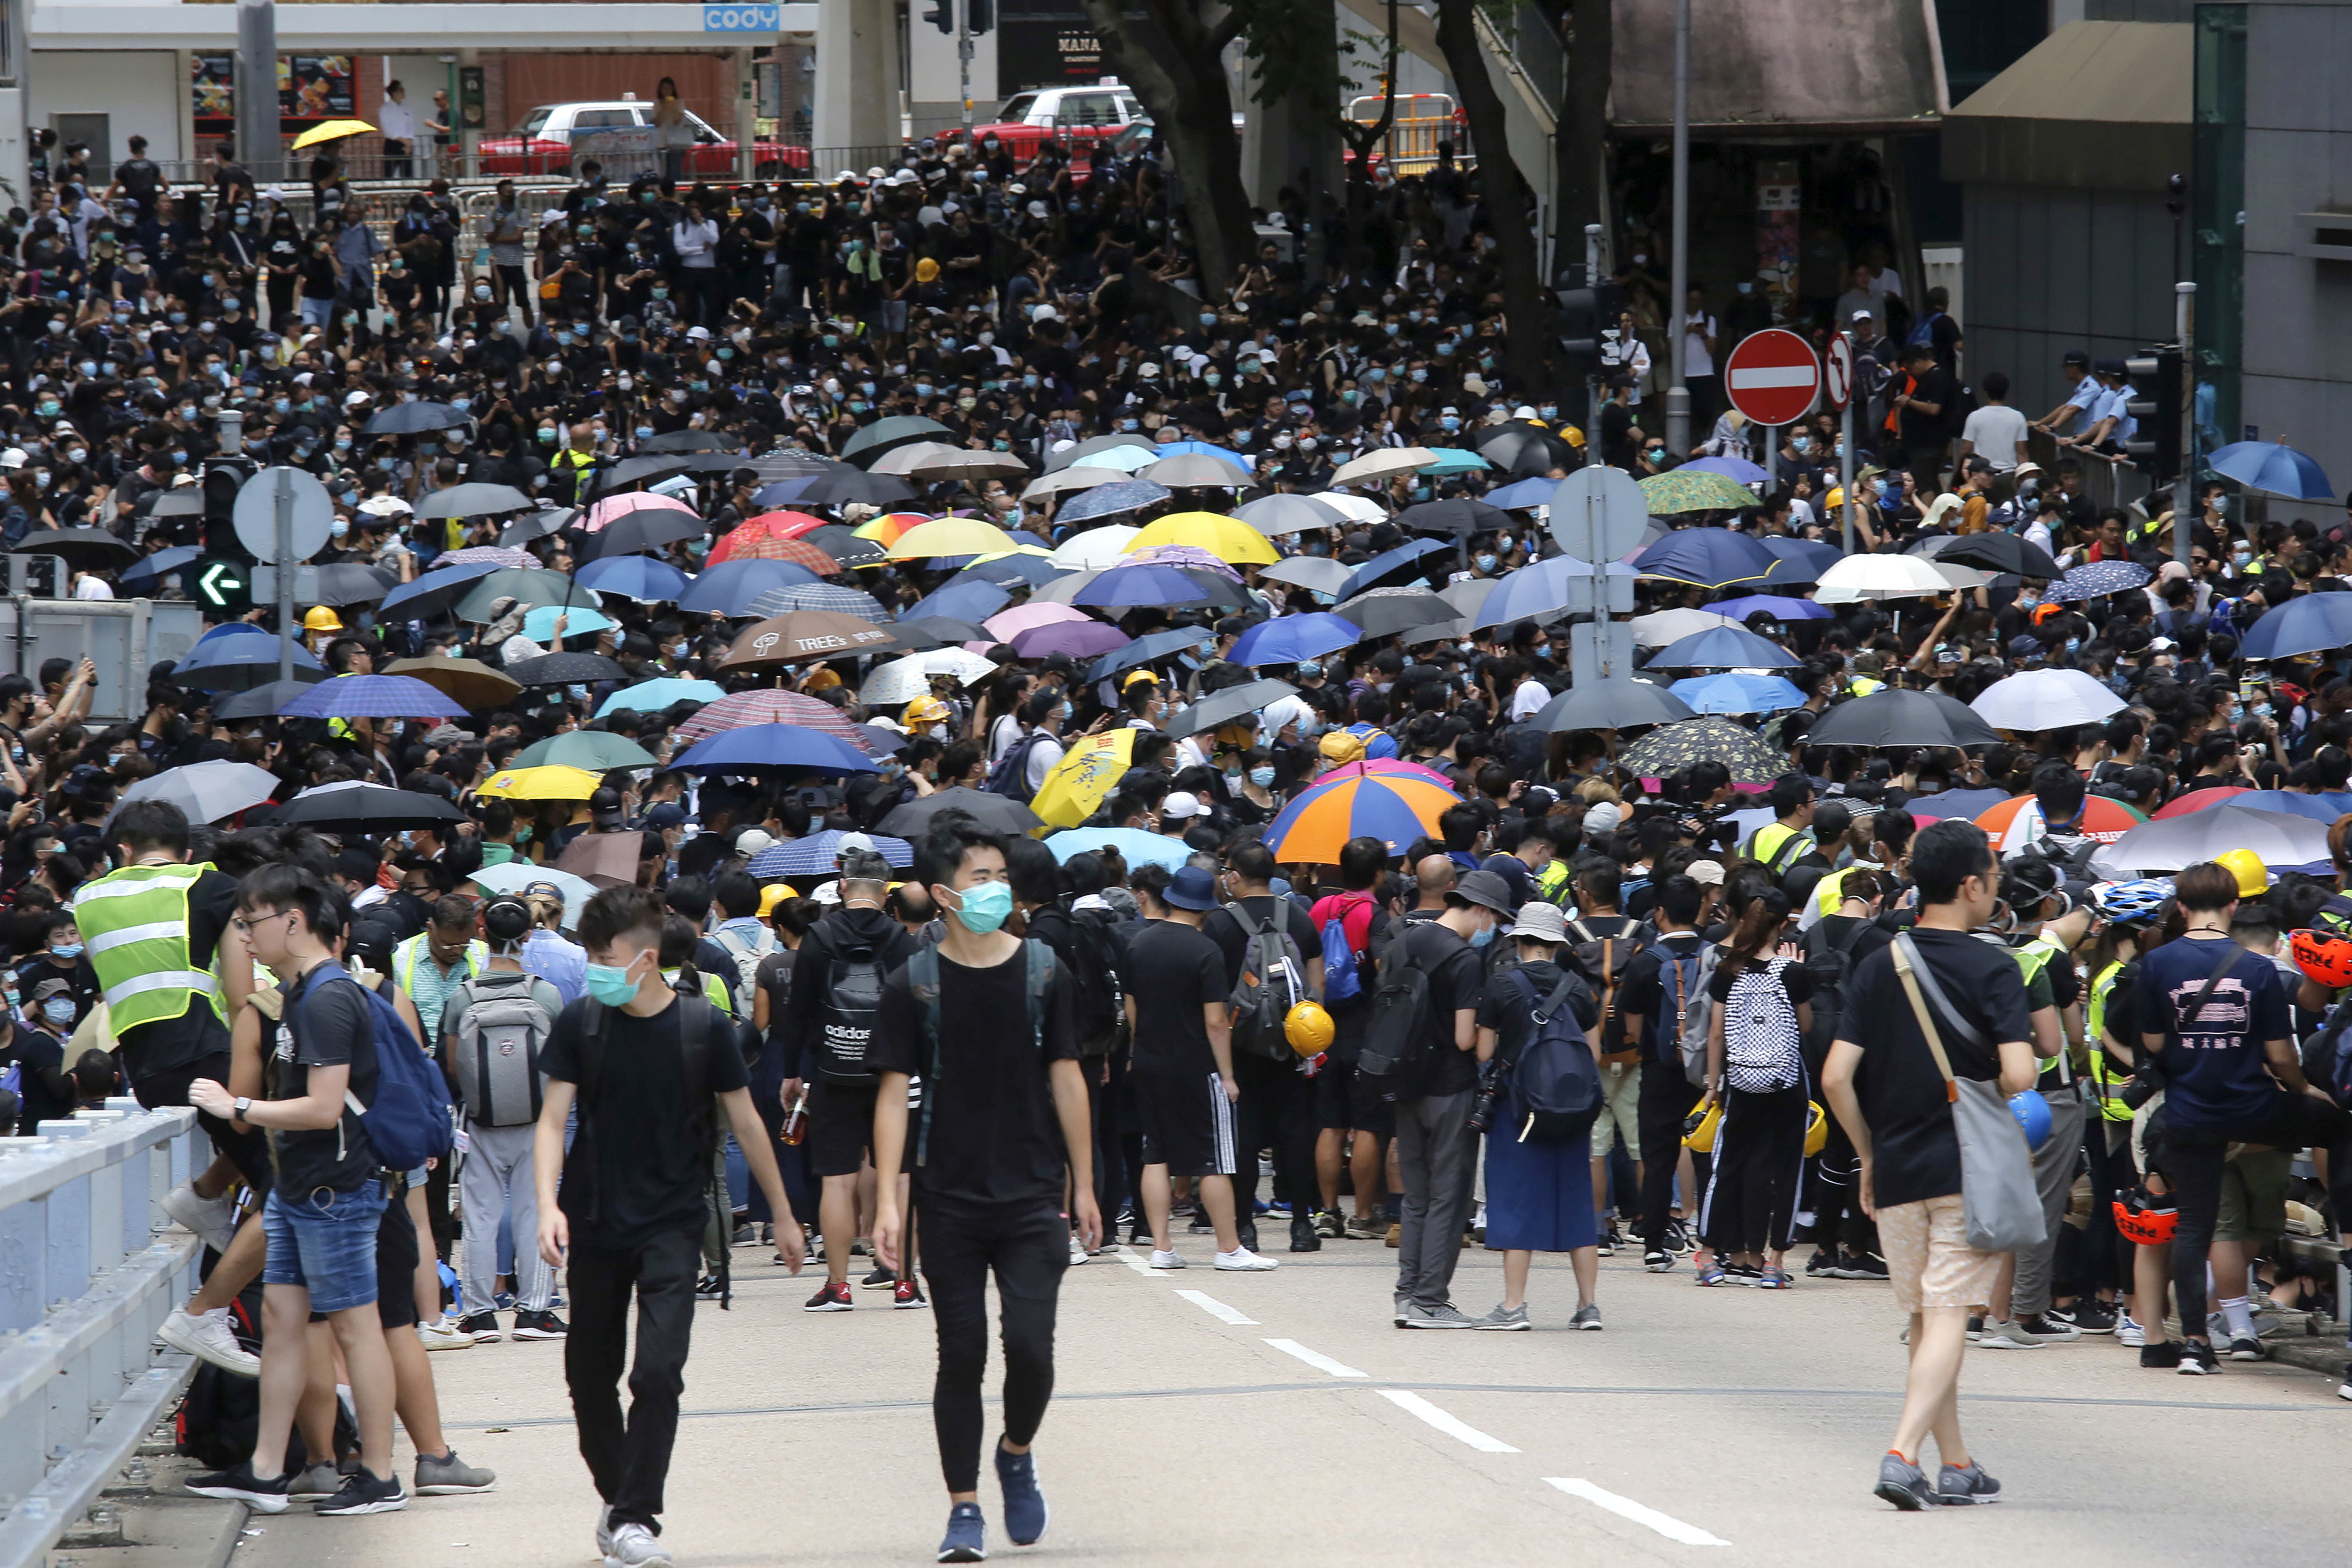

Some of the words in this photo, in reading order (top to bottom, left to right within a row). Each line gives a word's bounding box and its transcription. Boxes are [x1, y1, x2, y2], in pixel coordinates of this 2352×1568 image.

[707, 7, 777, 29] cody
[795, 635, 847, 651] TREE's
[825, 1025, 871, 1039] adidas
